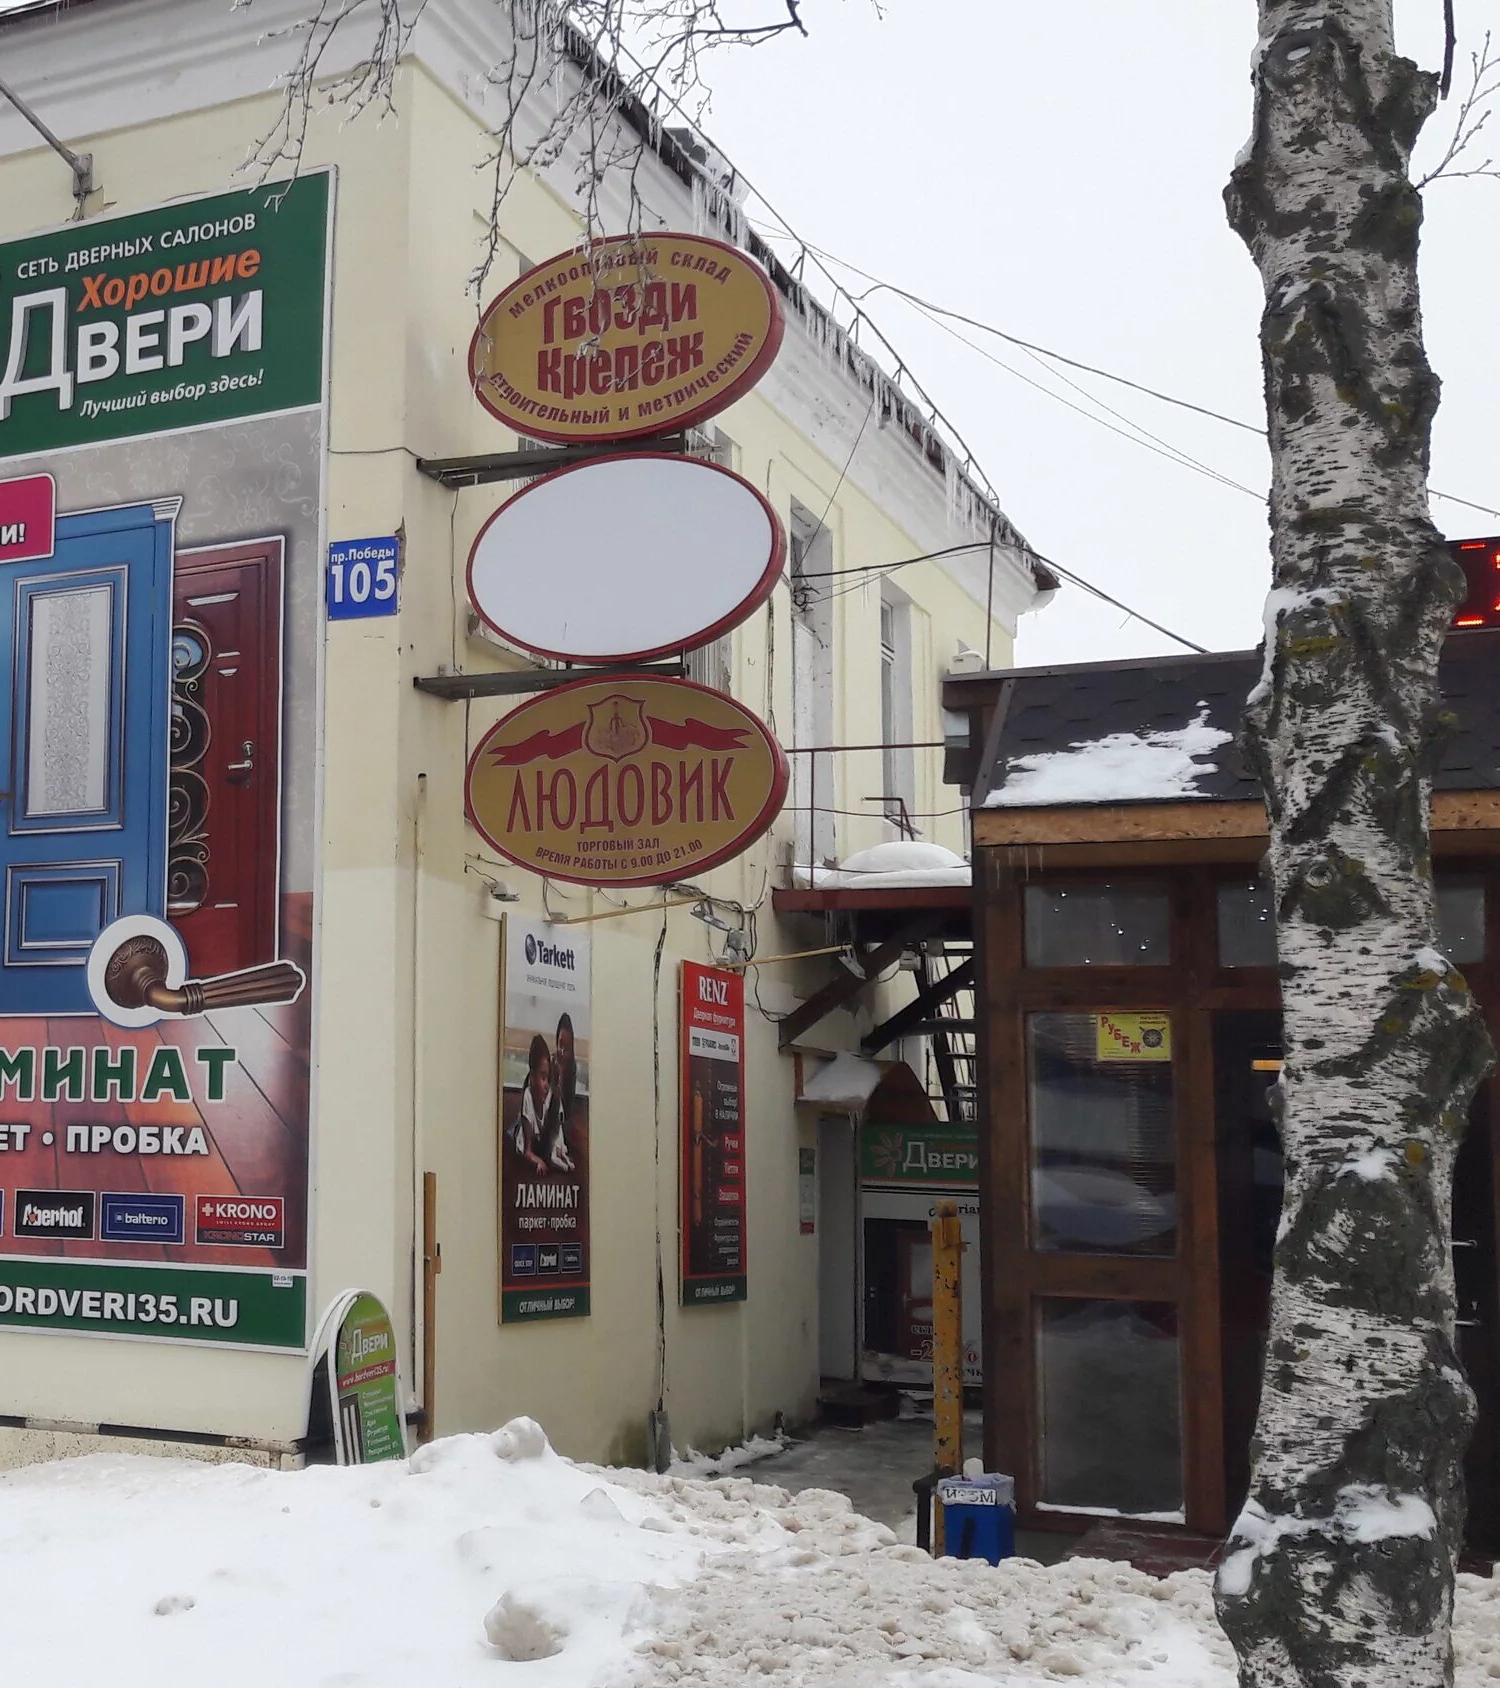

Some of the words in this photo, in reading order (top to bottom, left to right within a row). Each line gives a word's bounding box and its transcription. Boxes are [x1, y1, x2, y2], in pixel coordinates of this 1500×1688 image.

[17, 256, 60, 280] СЕТЬ
[64, 235, 154, 275] ДВЕРНЫХ
[159, 213, 257, 249] САЛОНОВ
[76, 248, 262, 312] Хорошие
[670, 251, 732, 286] склад
[79, 390, 147, 419] Лучший
[150, 381, 207, 411] выбор
[209, 368, 264, 400] здесь!
[489, 371, 610, 425] строительный
[618, 406, 629, 421] и
[638, 331, 754, 418] метрический
[331, 560, 396, 603] 105
[506, 757, 735, 834] ЛЮДОВИК
[535, 846, 571, 868] ВРЕМЯ
[573, 856, 618, 871] РАБОТЫ
[621, 859, 628, 870] С
[631, 856, 653, 870] 9.00
[656, 851, 671, 867] ДО
[674, 838, 703, 859] 21.00
[637, 837, 660, 850] ЗАЛ
[537, 940, 575, 971] Tarkett
[699, 975, 729, 1006] RENZ
[66, 1124, 209, 1156] ПРОБКА
[216, 1203, 277, 1220] KRONO
[515, 1183, 580, 1209] ЛАМИНАТ
[124, 1212, 169, 1226] balterio
[519, 1215, 547, 1232] паркет
[550, 1213, 577, 1232] пробка
